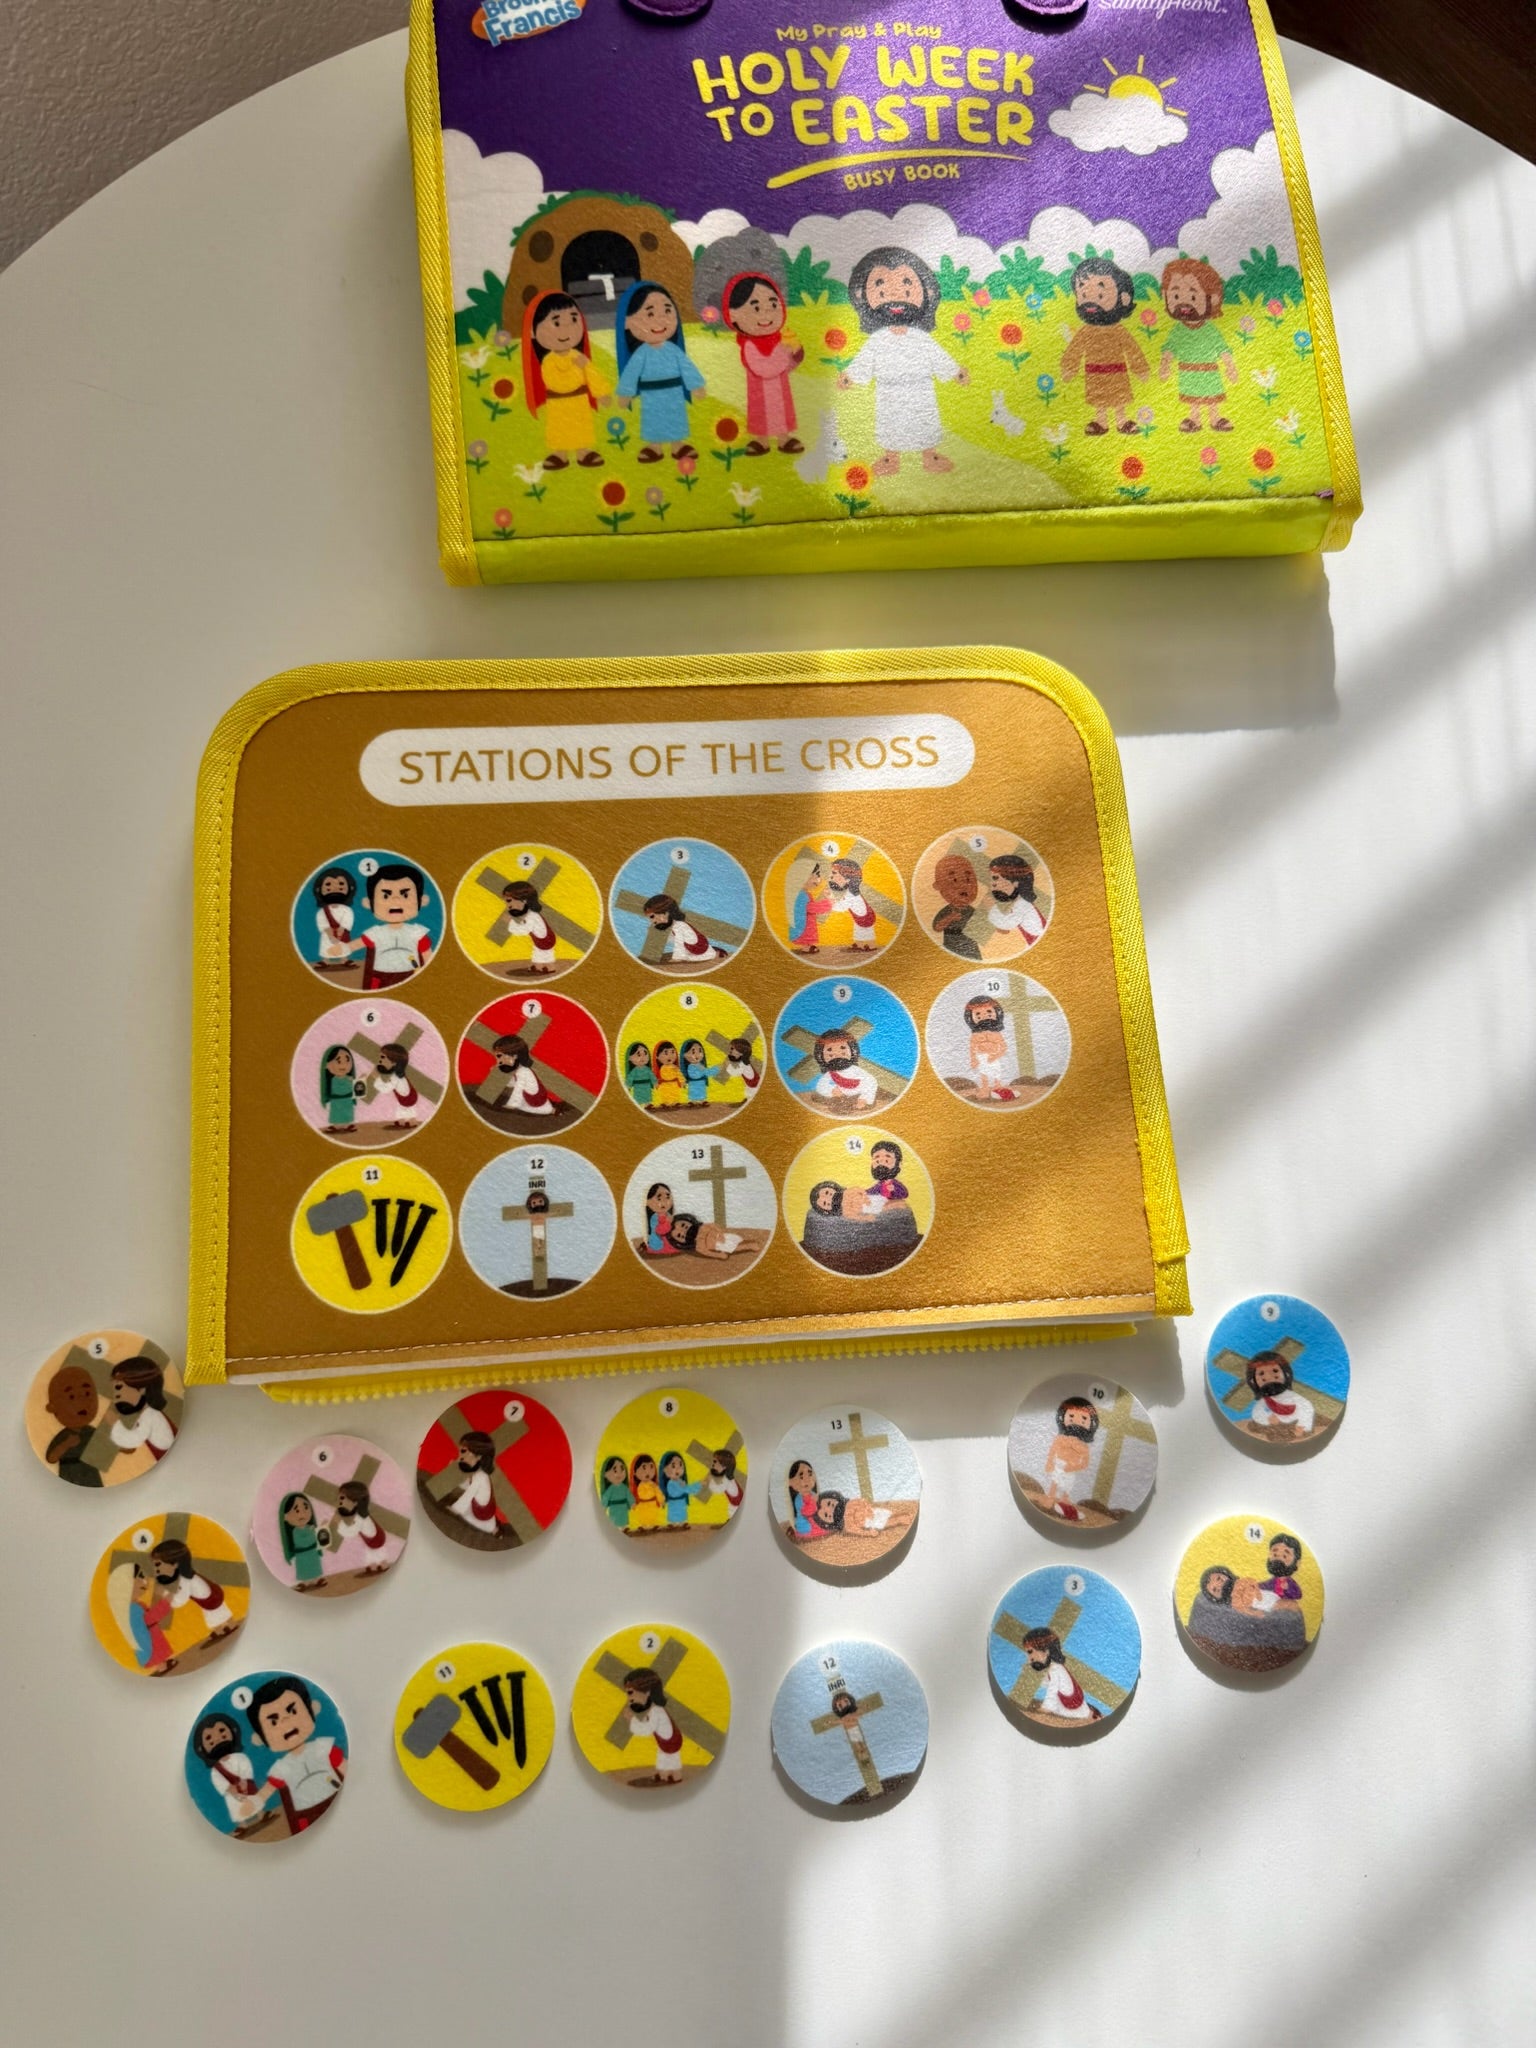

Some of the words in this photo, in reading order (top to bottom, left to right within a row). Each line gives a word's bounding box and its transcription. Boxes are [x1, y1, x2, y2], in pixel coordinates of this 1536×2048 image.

[484, 0, 581, 47] Francis
[776, 26, 808, 41] My
[812, 23, 867, 39] Pray
[873, 21, 887, 37] &
[893, 22, 942, 39] Play
[692, 45, 852, 104] HOLY
[877, 45, 1035, 96] WEEK
[705, 102, 775, 142] TO
[790, 94, 1036, 146] EASTER
[844, 168, 896, 190] BUSY
[904, 163, 960, 182] BOOK
[399, 746, 612, 784] STATIONS
[628, 744, 687, 777] OF
[701, 741, 785, 774] THE
[800, 735, 939, 771] CROSS
[976, 839, 981, 847] 5
[678, 851, 683, 859] 3
[524, 857, 530, 865] 2
[366, 863, 371, 871] 1
[988, 983, 999, 991] 10
[840, 989, 845, 997] 9
[686, 996, 692, 1005] 8
[529, 1004, 535, 1013] 7
[367, 1013, 374, 1022] 6
[849, 1140, 861, 1149] 14
[692, 1149, 704, 1159] 13
[531, 1159, 544, 1169] 12
[366, 1170, 378, 1180] 11
[528, 1180, 546, 1188] INRI
[1267, 1307, 1273, 1316] 9
[96, 1344, 102, 1354] 5
[1093, 1388, 1104, 1399] 10
[511, 1407, 518, 1416] 7
[666, 1402, 672, 1412] 8
[831, 1420, 842, 1430] 13
[319, 1452, 326, 1461] 6
[1250, 1528, 1261, 1538] 14
[140, 1536, 147, 1544] 4
[1072, 1581, 1078, 1590] 3
[647, 1638, 653, 1648] 2
[823, 1658, 836, 1669] 12
[439, 1666, 451, 1678] 11
[239, 1694, 246, 1703] 1
